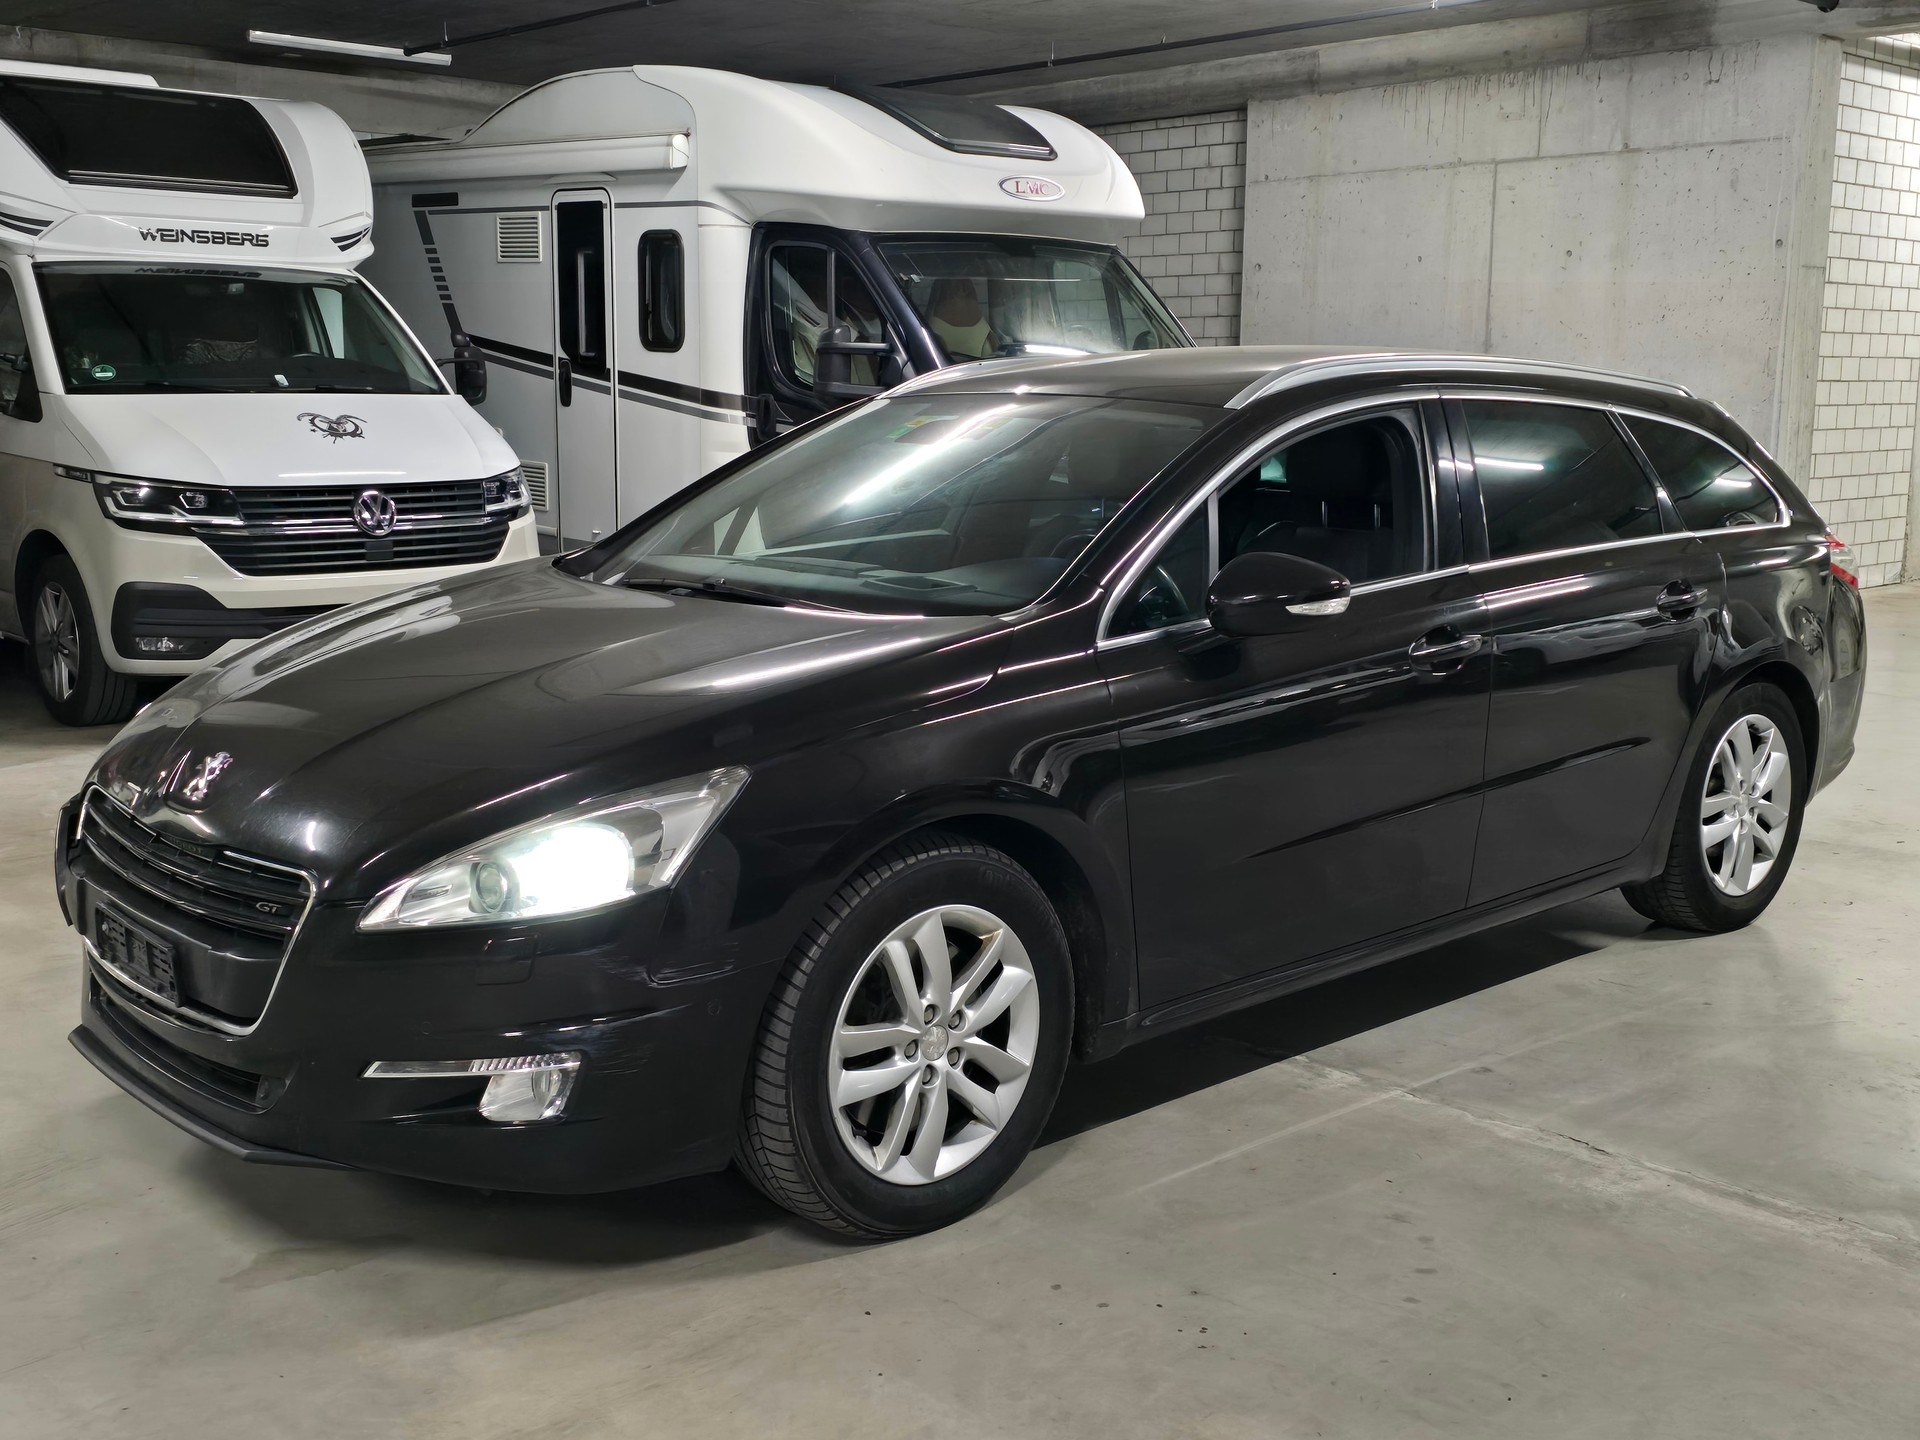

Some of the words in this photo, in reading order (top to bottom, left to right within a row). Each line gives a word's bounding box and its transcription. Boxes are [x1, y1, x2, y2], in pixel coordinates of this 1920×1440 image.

[1014, 180, 1049, 196] LMC
[138, 227, 269, 247] WEINSBERG
[255, 901, 282, 914] GT
